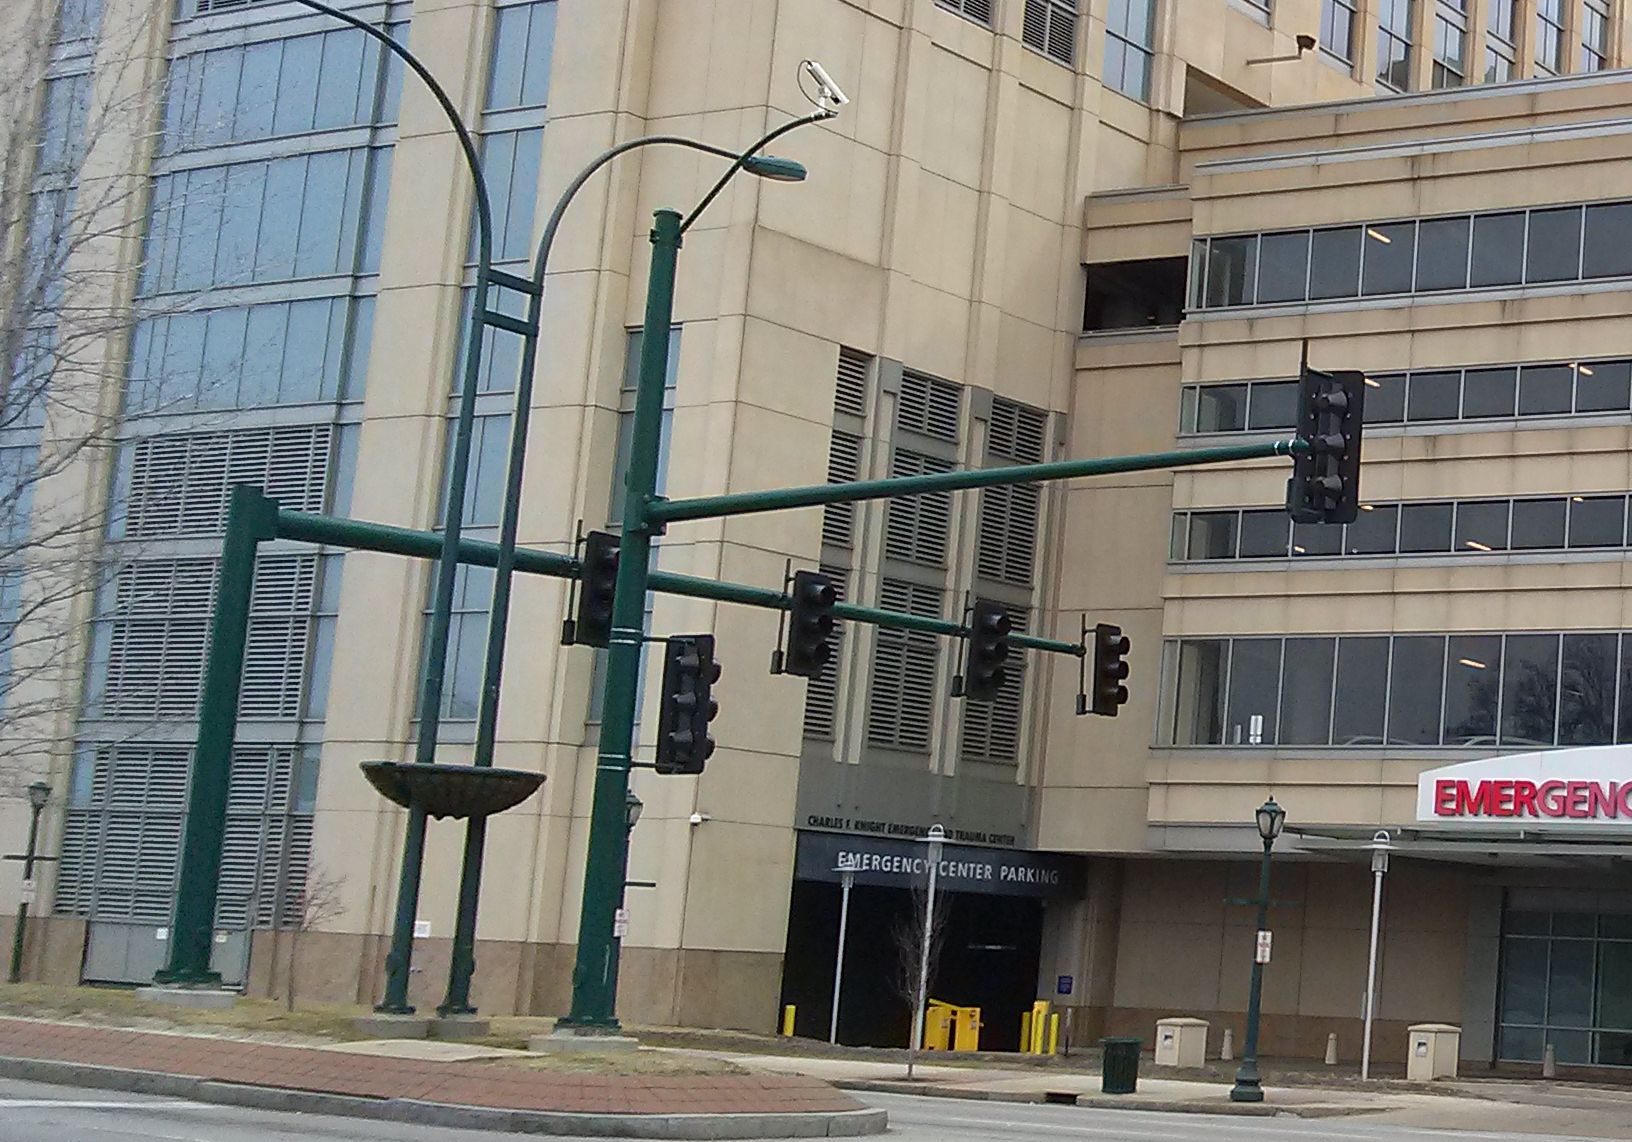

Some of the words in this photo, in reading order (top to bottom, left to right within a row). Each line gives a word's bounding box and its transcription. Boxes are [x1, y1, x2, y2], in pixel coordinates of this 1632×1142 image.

[808, 815, 843, 829] CHARLES
[855, 820, 886, 834] KNIGHT
[888, 823, 931, 838] EMERGEN
[955, 830, 987, 843] TRAUMA
[988, 833, 1015, 846] CENTER
[837, 851, 931, 874] EMERGENCY
[939, 860, 993, 880] CENTER
[1000, 865, 1060, 884] PARKING
